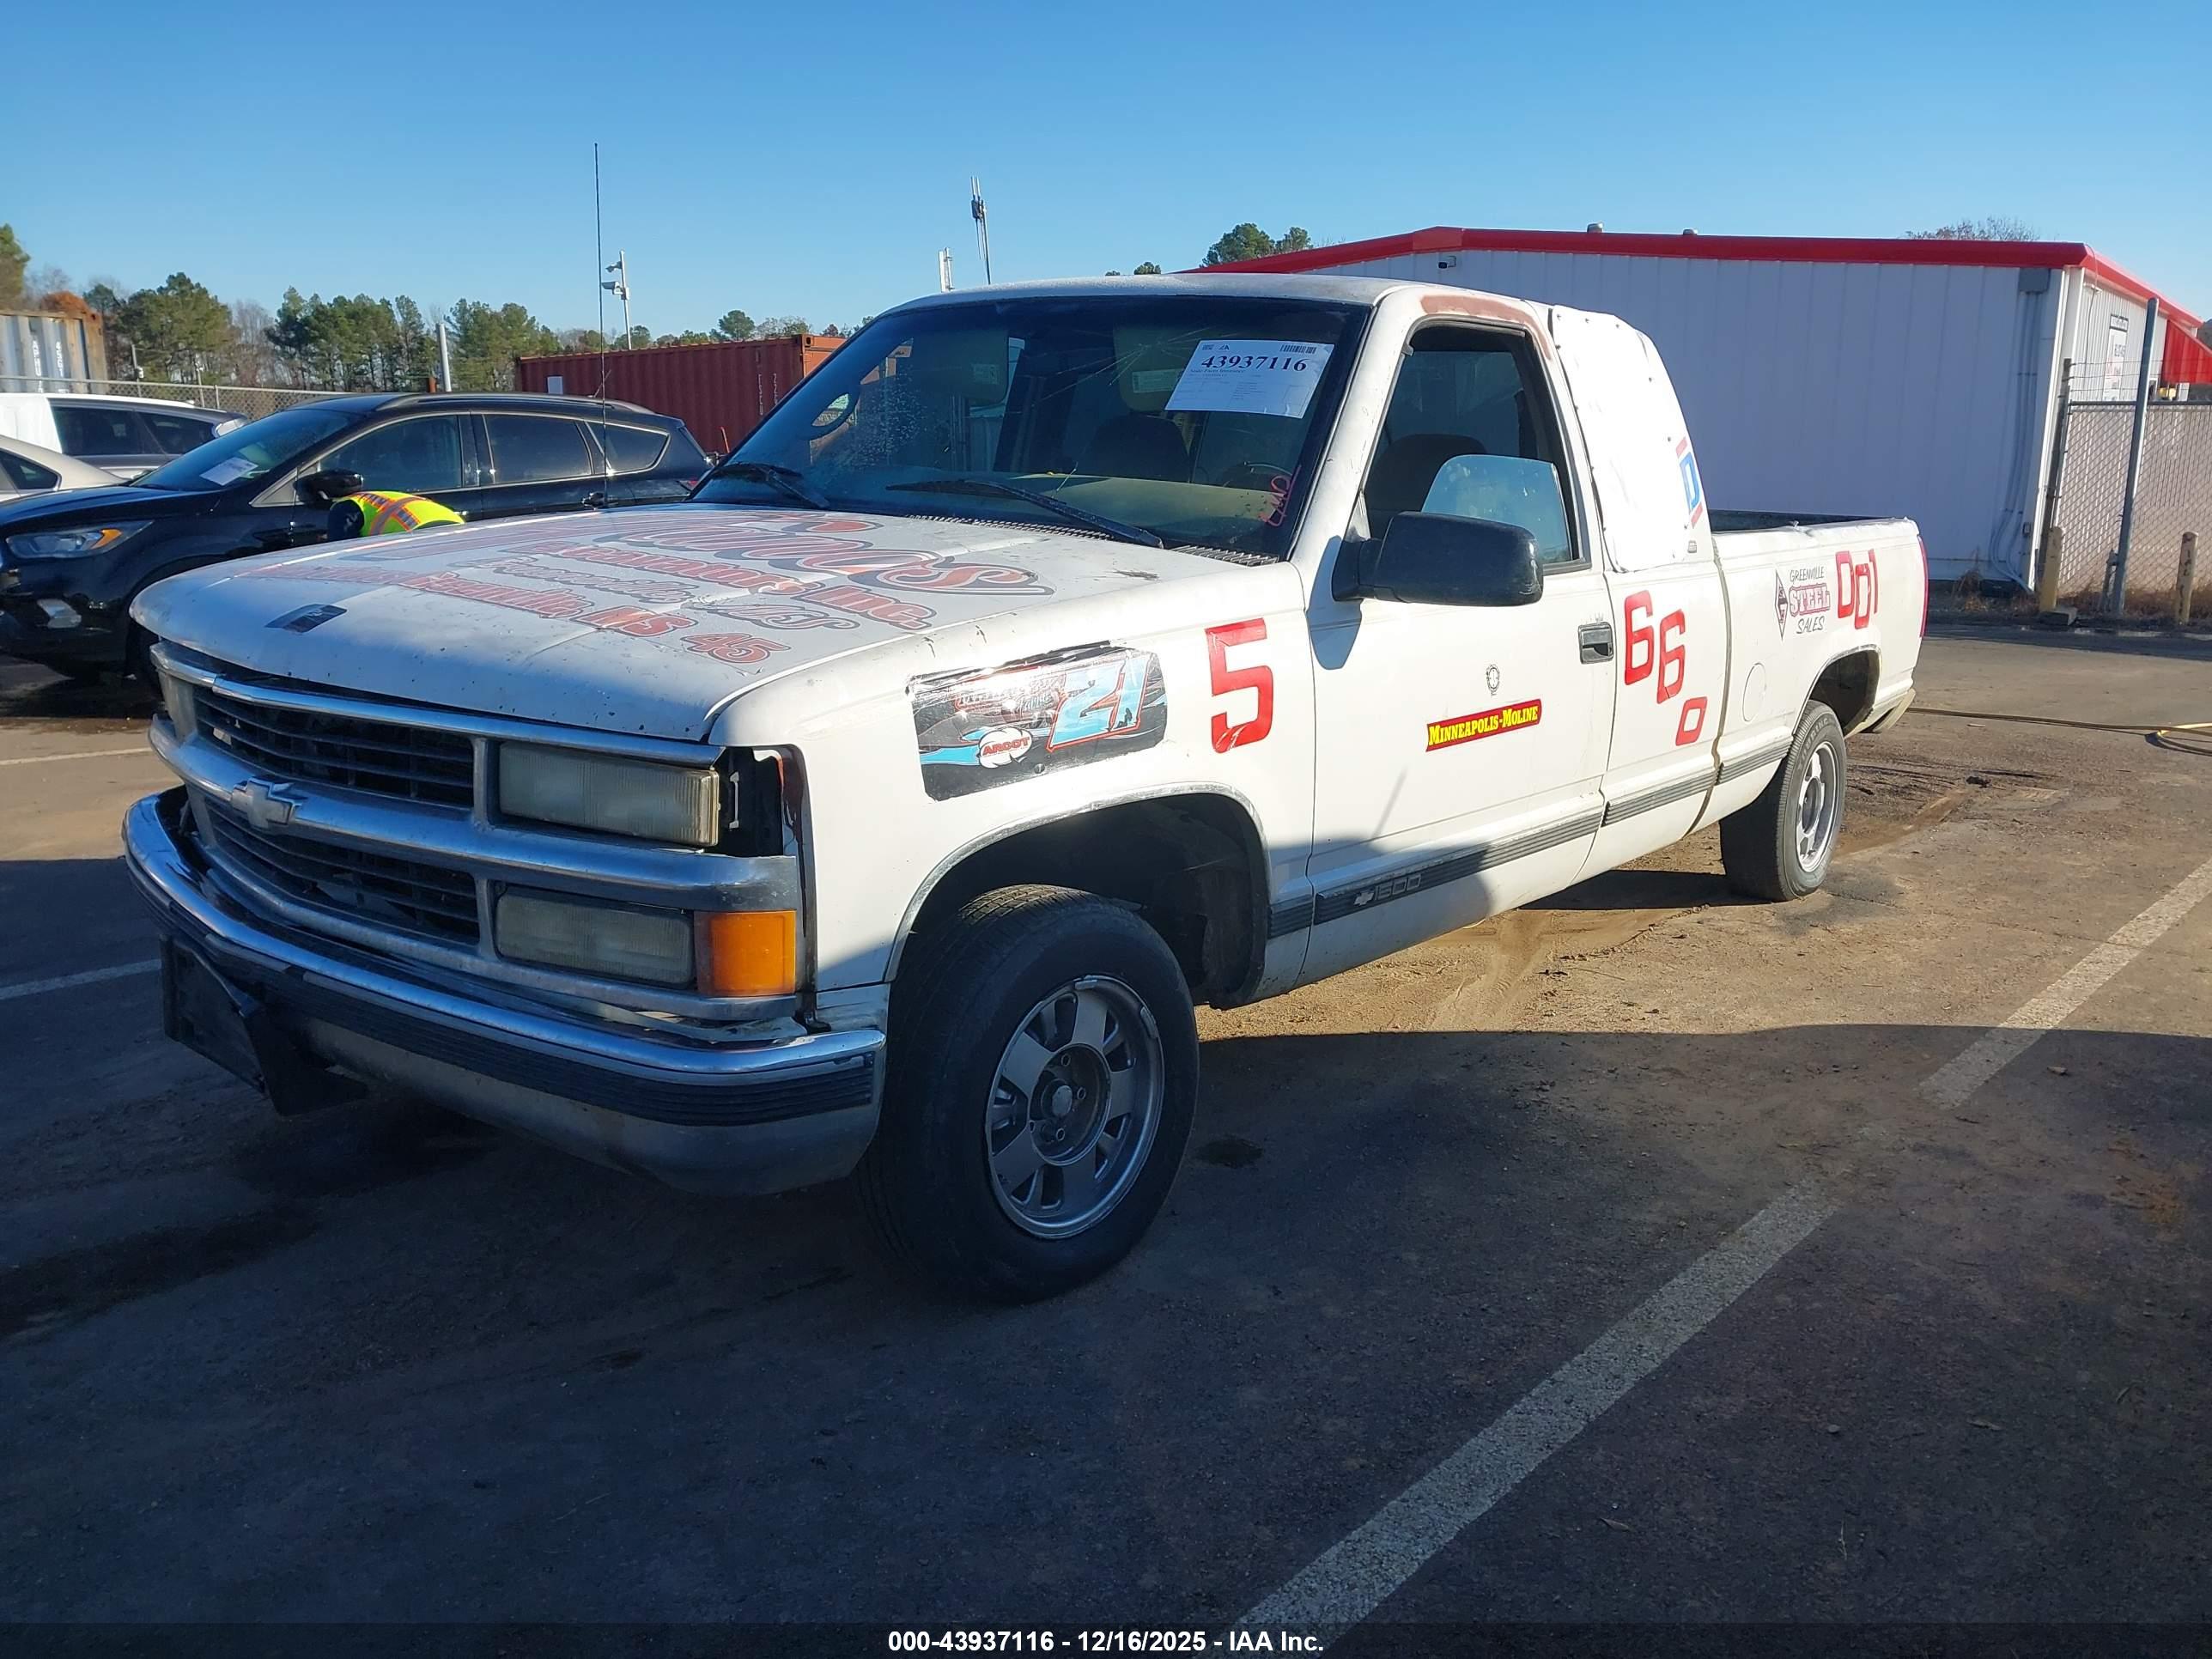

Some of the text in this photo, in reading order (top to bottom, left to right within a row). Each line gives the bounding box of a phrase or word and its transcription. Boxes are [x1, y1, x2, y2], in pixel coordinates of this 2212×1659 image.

[1201, 355, 1312, 372] 43937116
[1790, 565, 1825, 583] GREENVILLE
[791, 585, 937, 630] Inc.
[1789, 583, 1830, 617] STEEL
[570, 605, 699, 637] MS
[680, 633, 792, 665] 45
[1796, 616, 1825, 635] SALES
[1205, 617, 1274, 753] 5
[981, 736, 1030, 756] ARCOT
